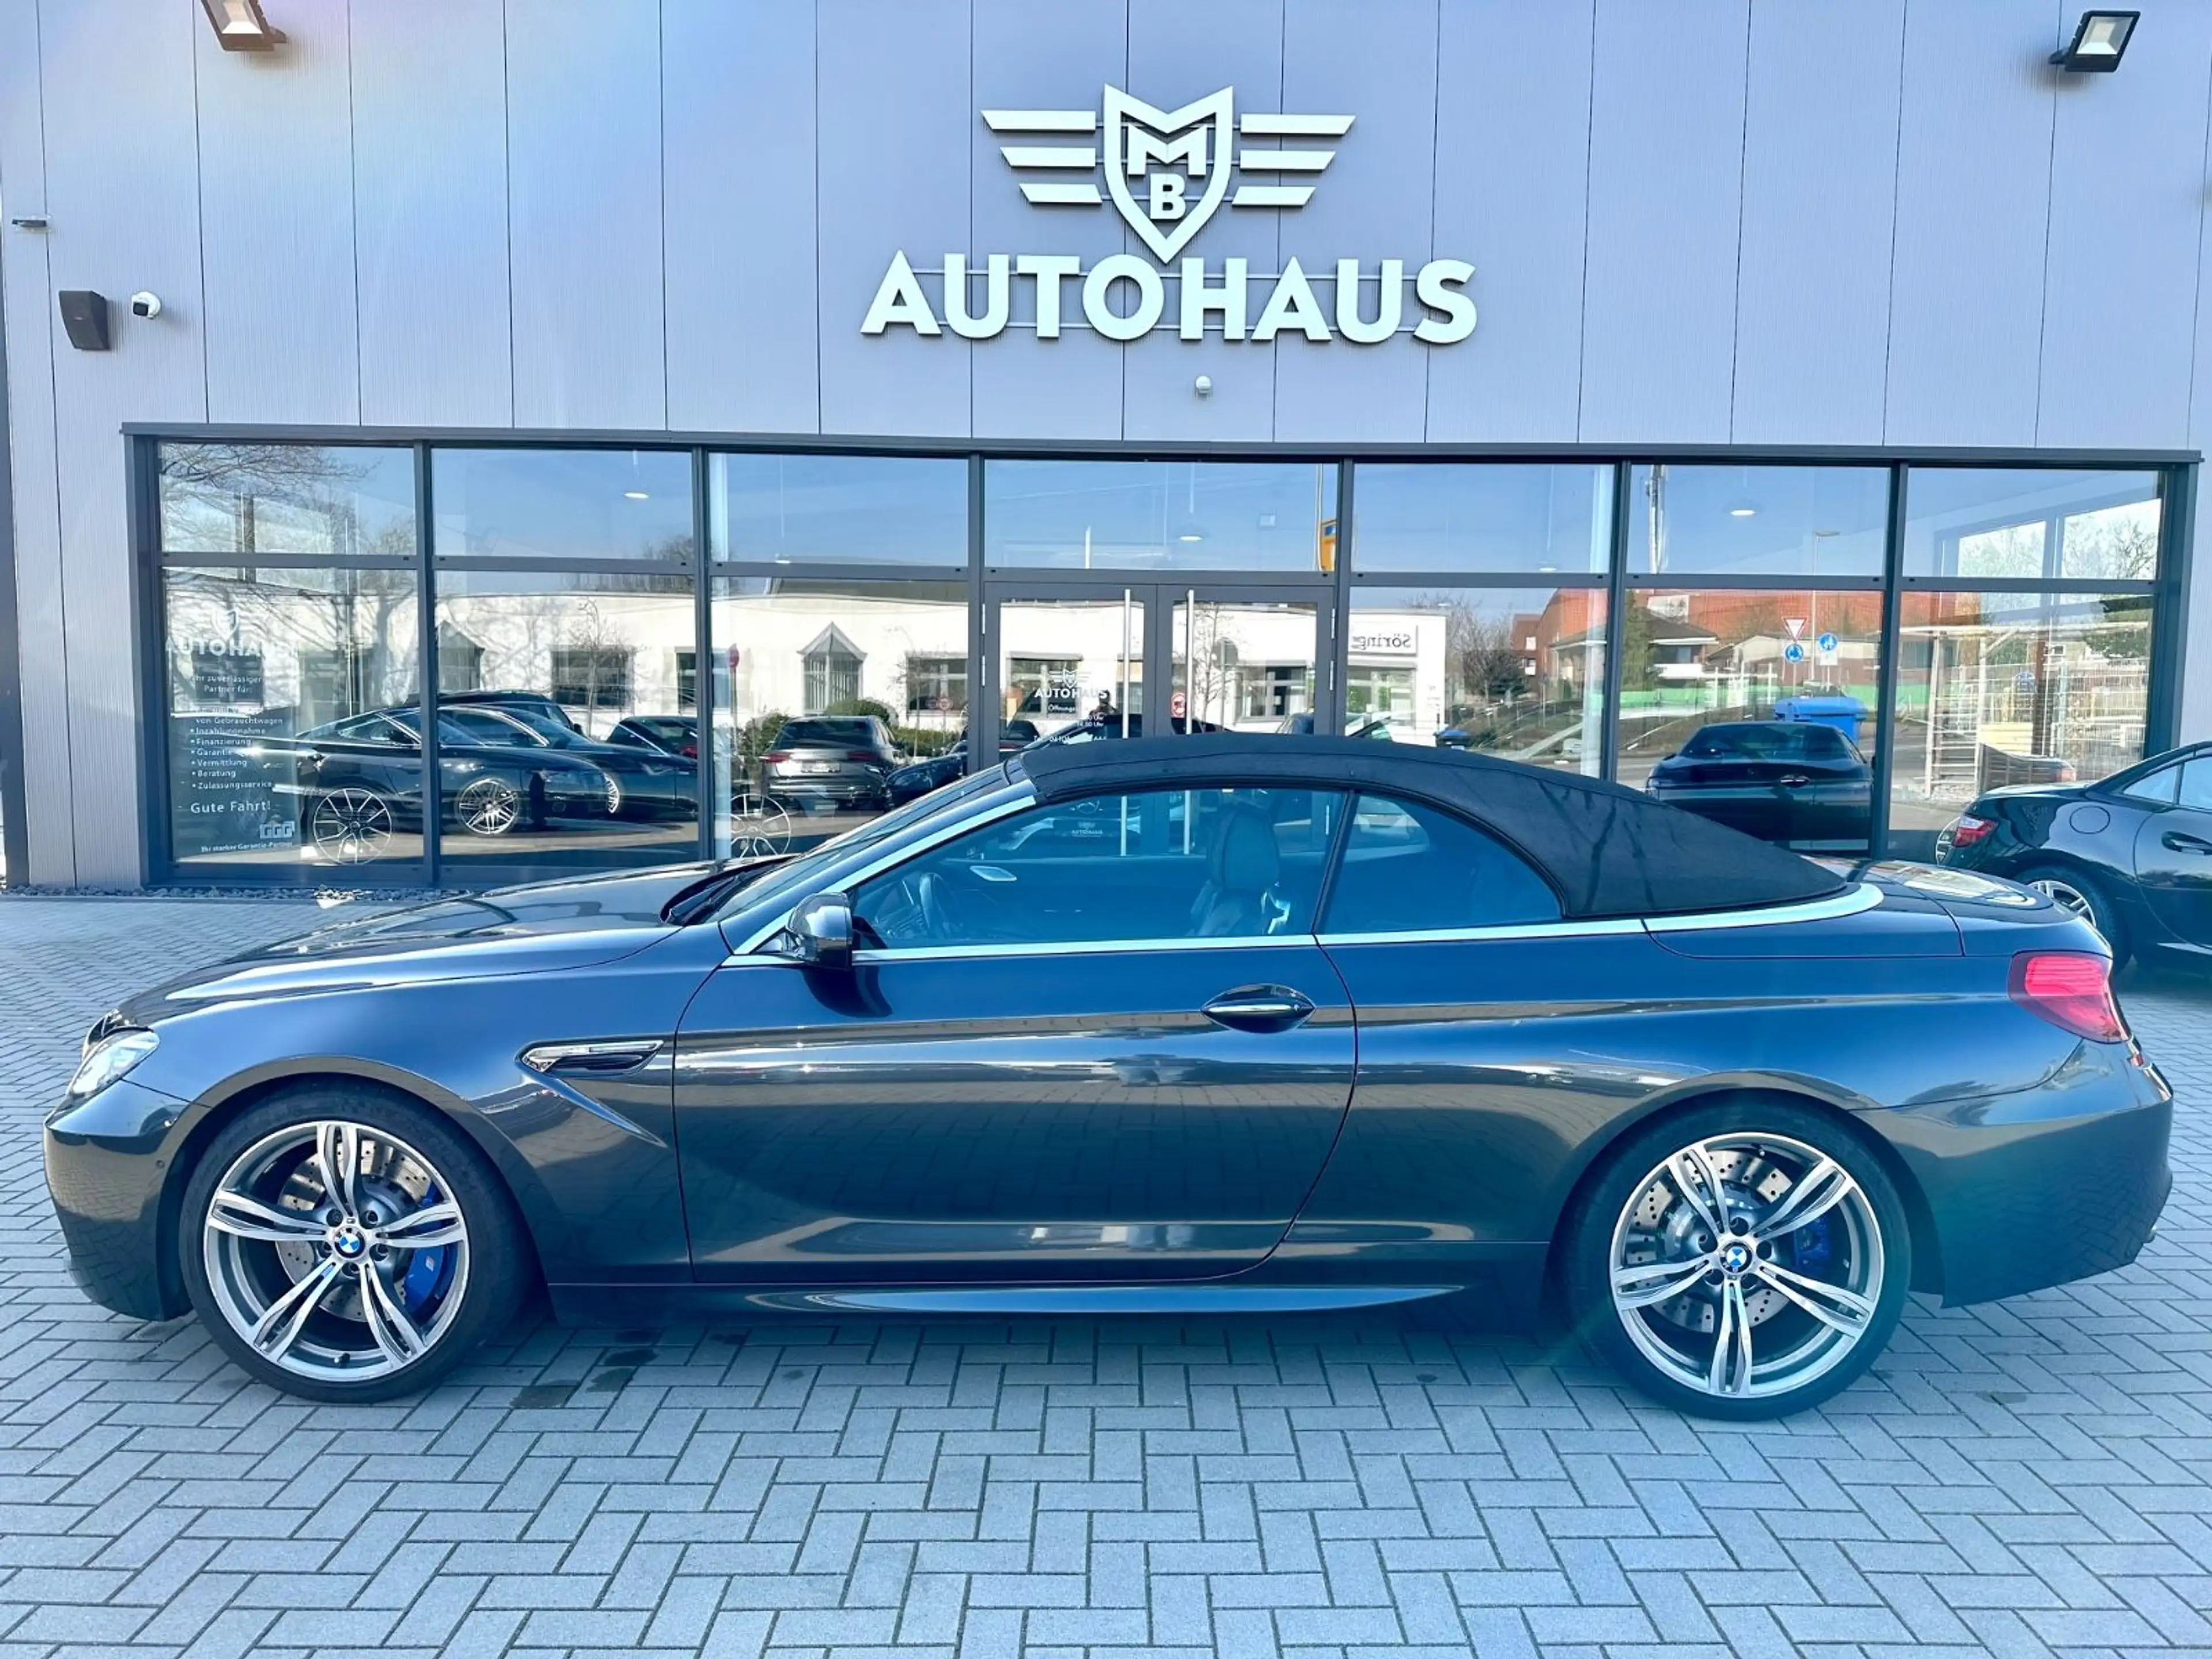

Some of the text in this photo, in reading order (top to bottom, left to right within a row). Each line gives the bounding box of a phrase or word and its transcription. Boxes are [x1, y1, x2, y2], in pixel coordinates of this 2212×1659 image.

[1127, 123, 1206, 176] M
[1149, 173, 1187, 219] B
[860, 249, 1478, 344] AUTOHAUS
[165, 637, 293, 656] AUTOHA
[214, 717, 283, 726] Gebrauchtwagen
[196, 738, 251, 748] Finanzierung
[197, 759, 247, 767] Vermittlung
[198, 770, 236, 778] Beratung
[198, 780, 272, 790] Zulassungsservice
[190, 800, 271, 813] Gute Fahrt!
